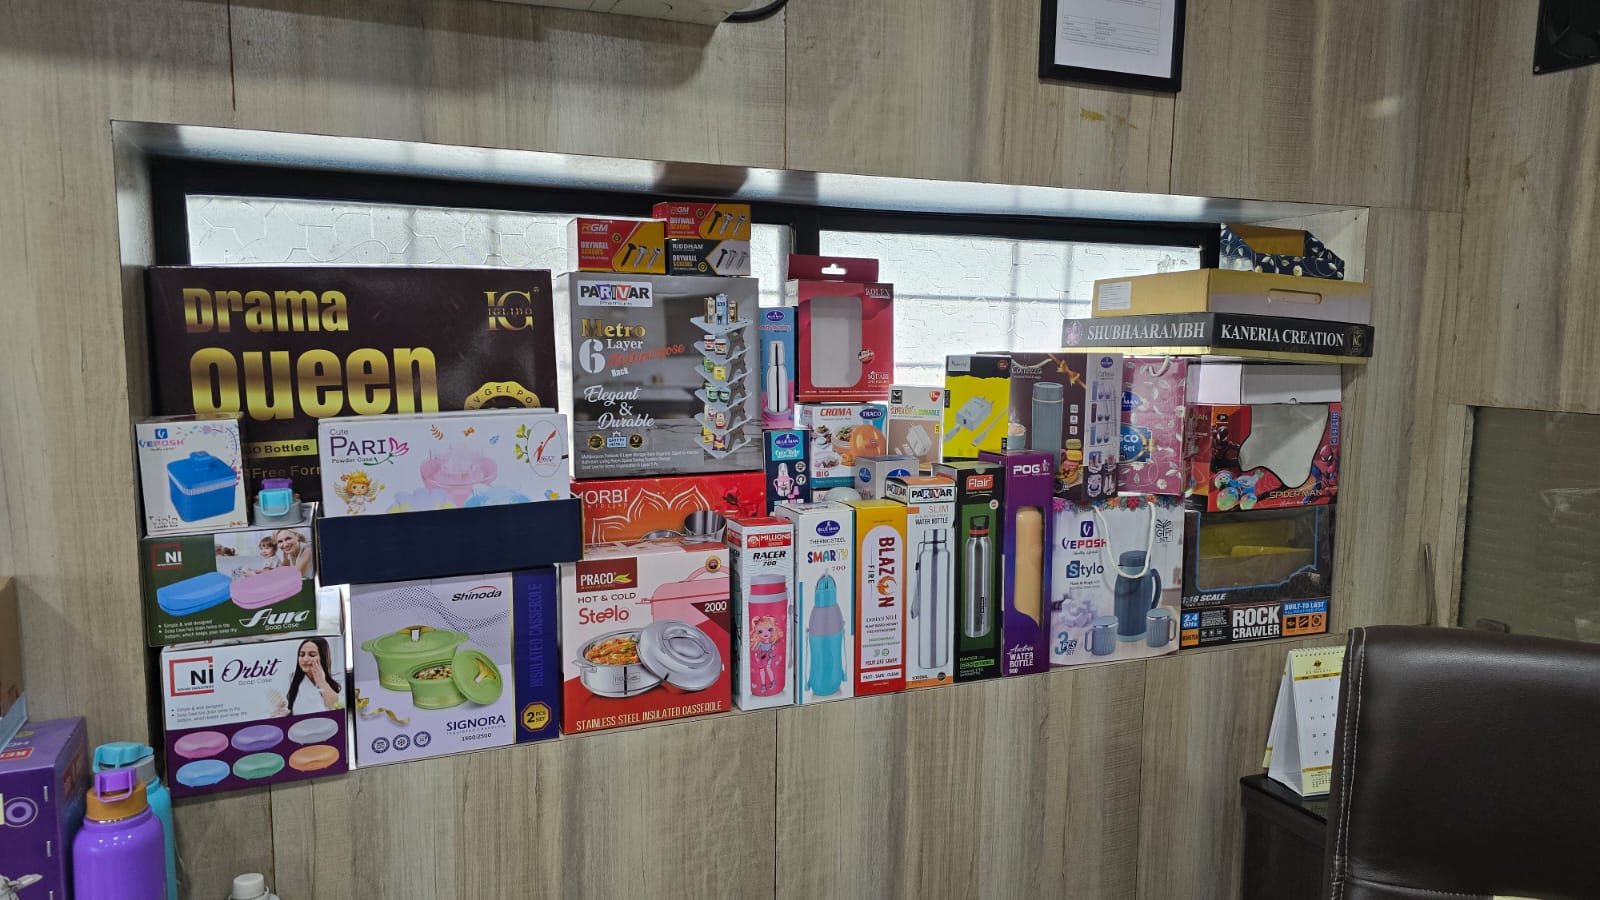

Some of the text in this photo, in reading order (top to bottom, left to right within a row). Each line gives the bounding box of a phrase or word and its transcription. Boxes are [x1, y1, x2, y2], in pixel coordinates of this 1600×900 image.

[582, 223, 609, 232] RGM
[580, 284, 651, 300] PARIVAR
[182, 288, 350, 334] Drama
[581, 319, 647, 338] Metro
[1087, 321, 1205, 341] SHUBHAARAMBH
[1221, 324, 1345, 348] KANERIA CREATION
[607, 338, 644, 351] Layer
[578, 338, 606, 374] 6
[189, 346, 440, 421] Queen
[583, 384, 642, 406] Elegant
[618, 401, 633, 416] &
[820, 407, 852, 417] CROMA
[597, 412, 655, 430] Durable
[329, 427, 349, 436] Cute
[138, 439, 185, 448] VEPOSH
[264, 443, 310, 454] Bottles
[329, 435, 387, 457] PARI
[1123, 444, 1135, 452] Set
[331, 457, 356, 465] Powder
[252, 467, 288, 479] Free
[815, 470, 830, 478] BIG
[967, 478, 993, 488] Flair
[911, 488, 953, 500] PARIVAR
[927, 505, 949, 514] SLIM
[752, 550, 787, 560] RACER
[807, 548, 849, 564] SMARTY
[1067, 561, 1105, 578] Stylo
[580, 571, 614, 586] PRACO
[451, 588, 503, 602] Shinoda
[577, 592, 637, 604] HOT & COLD
[1200, 593, 1227, 602] SCALE
[527, 583, 544, 636] CASSEROLE
[704, 601, 728, 613] 2000
[1310, 601, 1325, 609] LAST
[1184, 613, 1198, 622] 2.4
[1232, 605, 1281, 628] ROCK
[264, 621, 300, 632] Soap Case
[1232, 624, 1280, 640] CRAWLER
[1054, 631, 1069, 656] 3
[1009, 652, 1034, 661] WATER
[1009, 659, 1034, 668] BOTTLE
[190, 663, 214, 686] Ni
[221, 658, 283, 683] Orbit
[527, 711, 535, 723] 2
[576, 700, 722, 731] STAINLESS STEEL INSULATED CASSEROLE
[446, 714, 506, 732] SIGNORA
